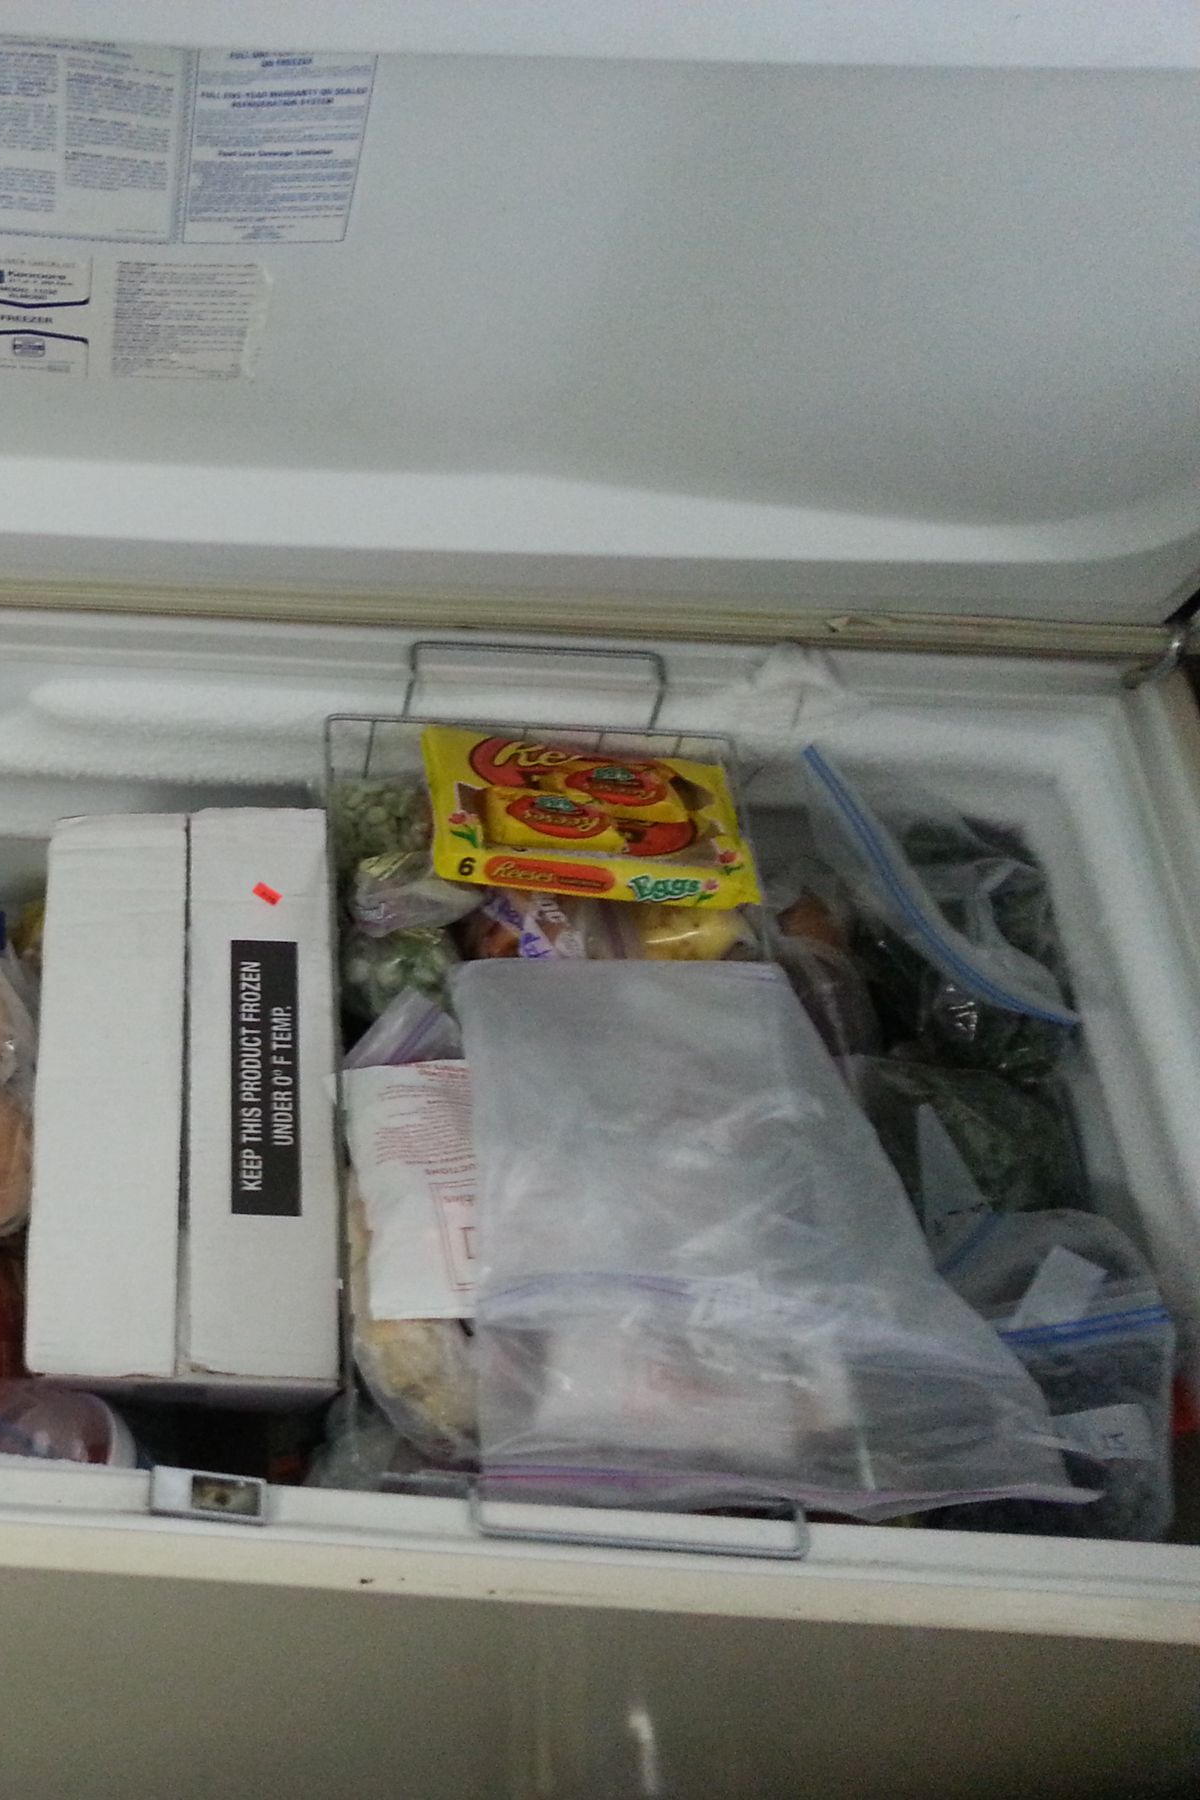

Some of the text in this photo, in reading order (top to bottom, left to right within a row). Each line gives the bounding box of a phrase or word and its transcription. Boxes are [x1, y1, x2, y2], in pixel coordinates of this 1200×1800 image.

[0, 314, 54, 324] FREEZER
[458, 856, 476, 878] 6
[627, 874, 702, 902] Eggs
[271, 1005, 293, 1050] TEMP.
[272, 1055, 292, 1065] F
[239, 961, 263, 1191] KEEP THIS PRODUCT FROZEN
[272, 1090, 294, 1146] UNDER
